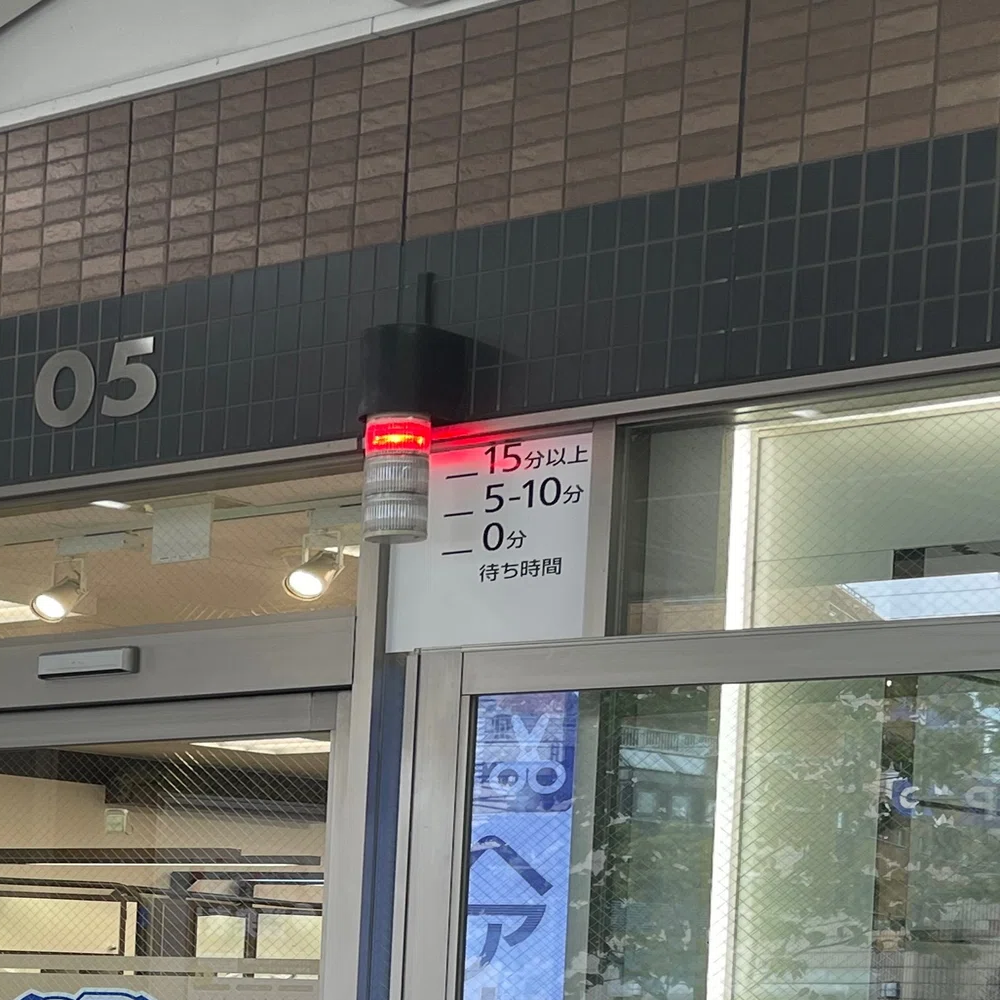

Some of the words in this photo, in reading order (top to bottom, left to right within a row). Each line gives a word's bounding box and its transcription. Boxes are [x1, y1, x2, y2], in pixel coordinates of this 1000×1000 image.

[35, 336, 157, 428] 05
[484, 442, 588, 474] 15分以上
[485, 477, 584, 513] 5-10分
[483, 522, 527, 551] 0分
[479, 557, 562, 582] 待ち時間
